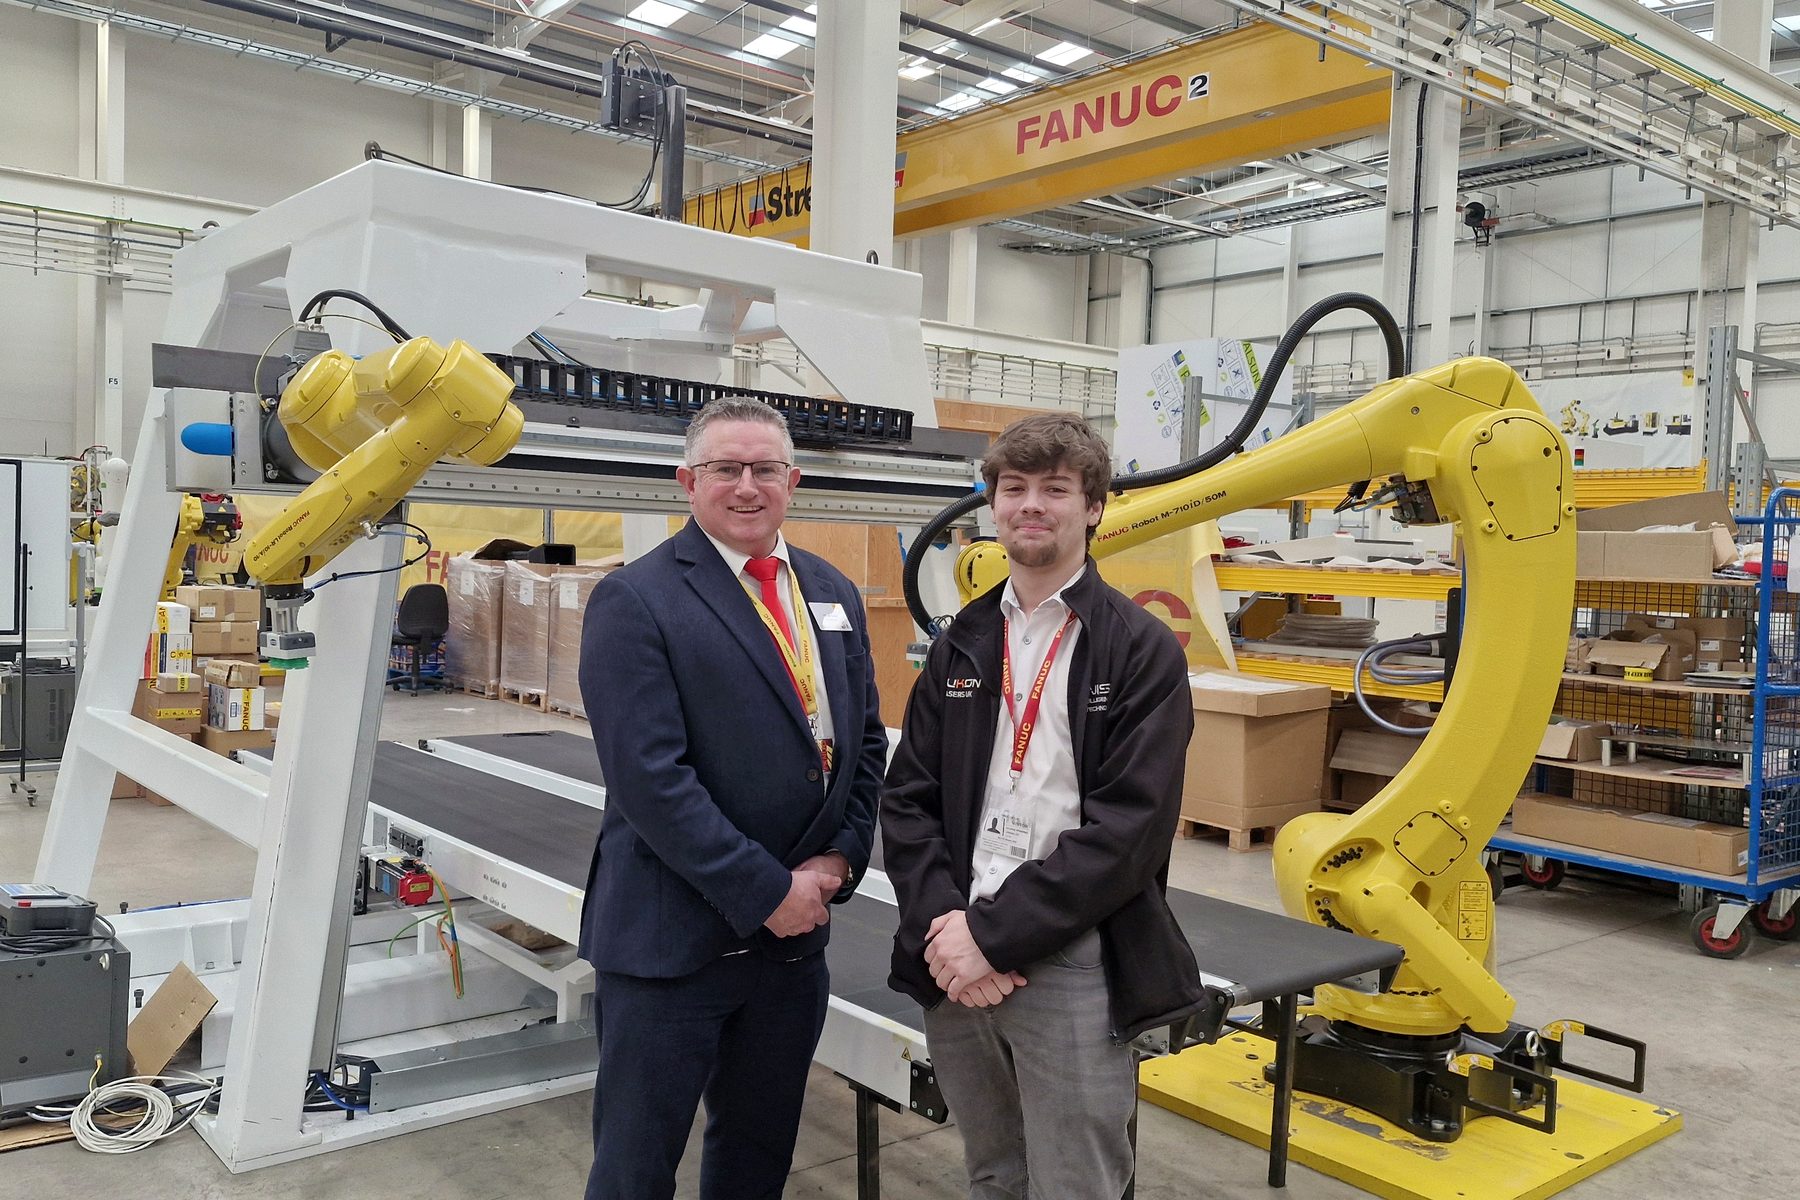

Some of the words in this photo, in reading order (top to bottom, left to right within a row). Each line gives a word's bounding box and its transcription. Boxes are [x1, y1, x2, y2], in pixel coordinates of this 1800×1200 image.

[1189, 75, 1208, 99] 2
[1016, 74, 1183, 156] FANUC
[1097, 526, 1130, 543] FANUC
[1131, 515, 1159, 530] Robot
[763, 613, 780, 635] FANUC
[799, 678, 812, 702] FANUC
[1002, 657, 1012, 695] FANUC
[1031, 659, 1052, 700] FANUC
[242, 701, 250, 731] FANUC
[1014, 721, 1032, 765] FANUC
